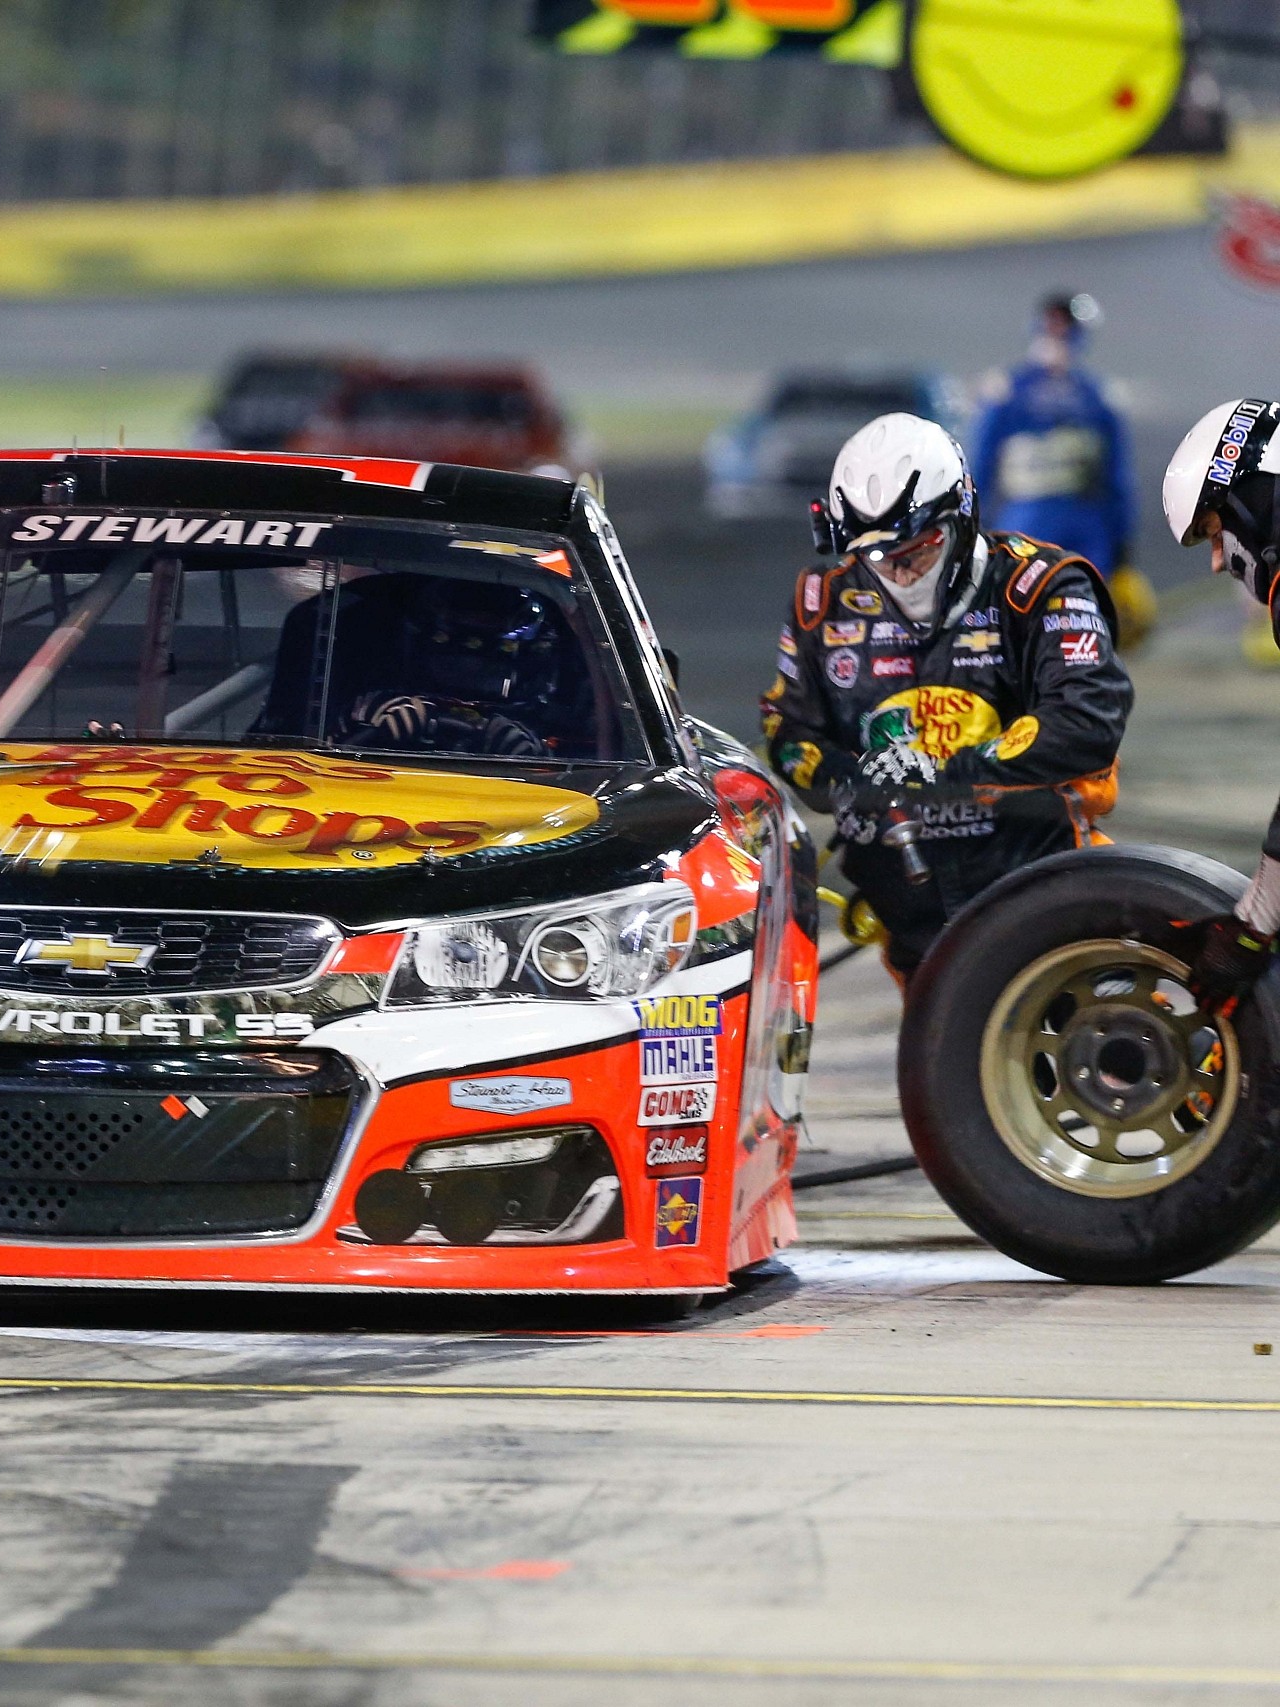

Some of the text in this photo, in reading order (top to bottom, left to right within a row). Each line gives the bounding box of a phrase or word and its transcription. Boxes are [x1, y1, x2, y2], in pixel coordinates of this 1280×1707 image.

[1207, 413, 1256, 486] Mobil
[11, 514, 333, 548] STEWART
[915, 687, 975, 719] Bass
[921, 717, 961, 744] Pro
[16, 744, 395, 782] Bass
[18, 760, 312, 796] Pro
[12, 785, 491, 857] Shops
[235, 1012, 315, 1037] SS
[638, 995, 718, 1029] MOOG
[643, 1038, 713, 1075] MAHLE
[645, 1089, 696, 1117] COMP
[646, 1136, 706, 1166] Edelbrock
